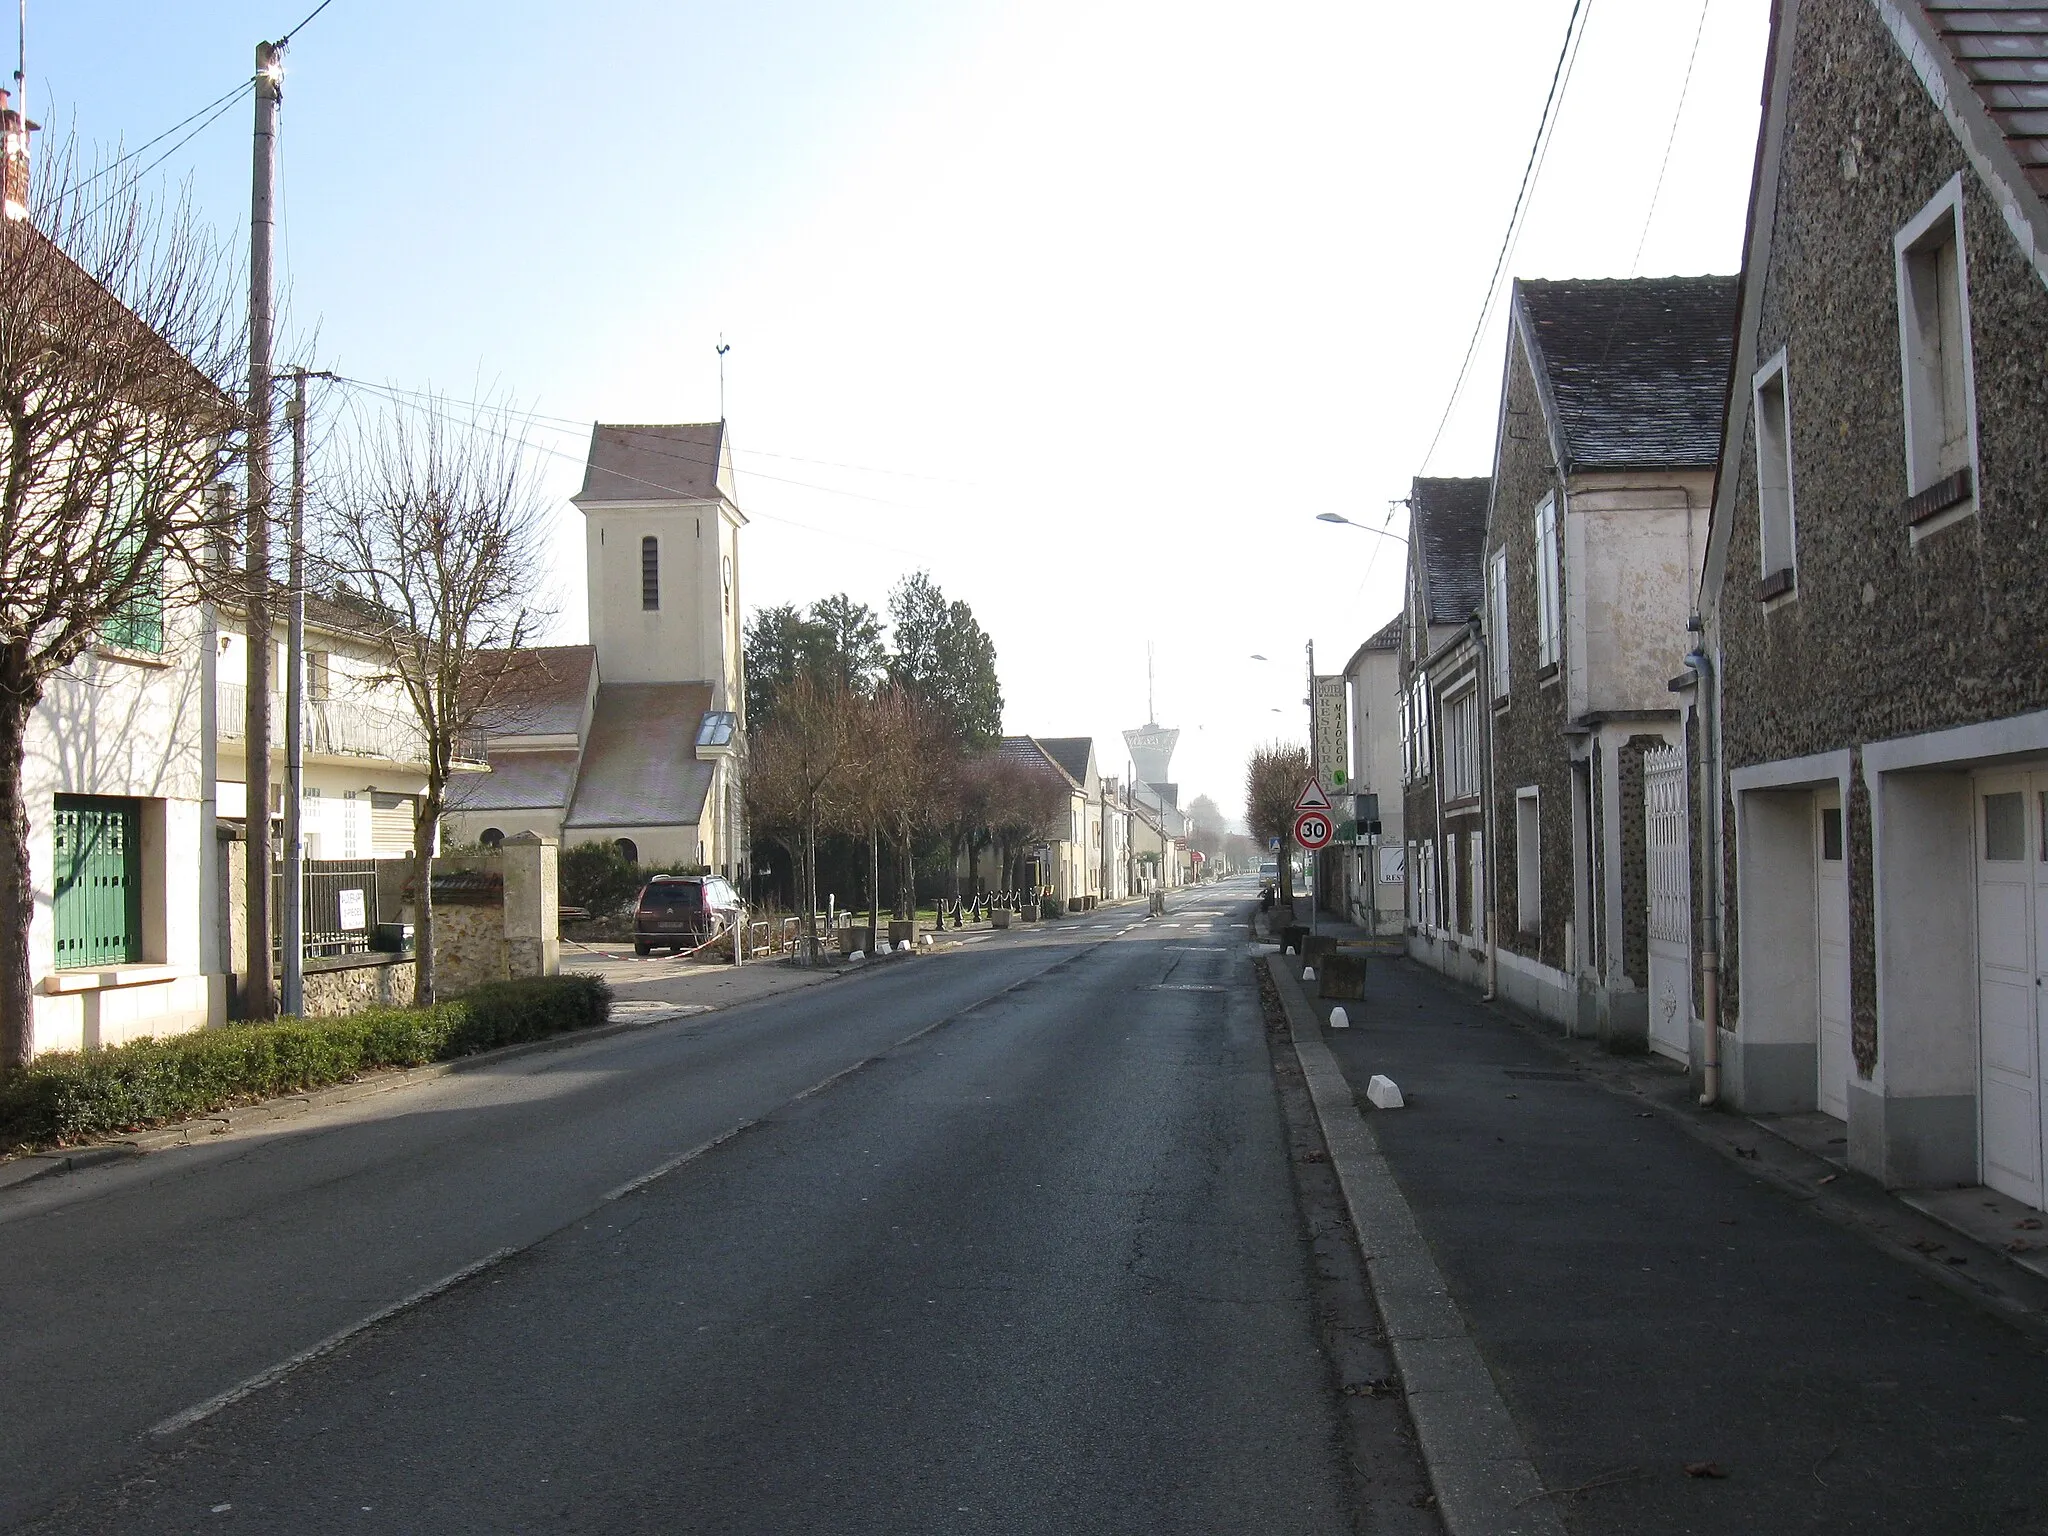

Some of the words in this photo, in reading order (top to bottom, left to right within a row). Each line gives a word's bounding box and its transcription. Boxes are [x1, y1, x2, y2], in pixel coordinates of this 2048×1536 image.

[1320, 699, 1332, 791] RESTAURANT
[1334, 704, 1343, 763] MALOCCO
[1302, 822, 1325, 838] 30
